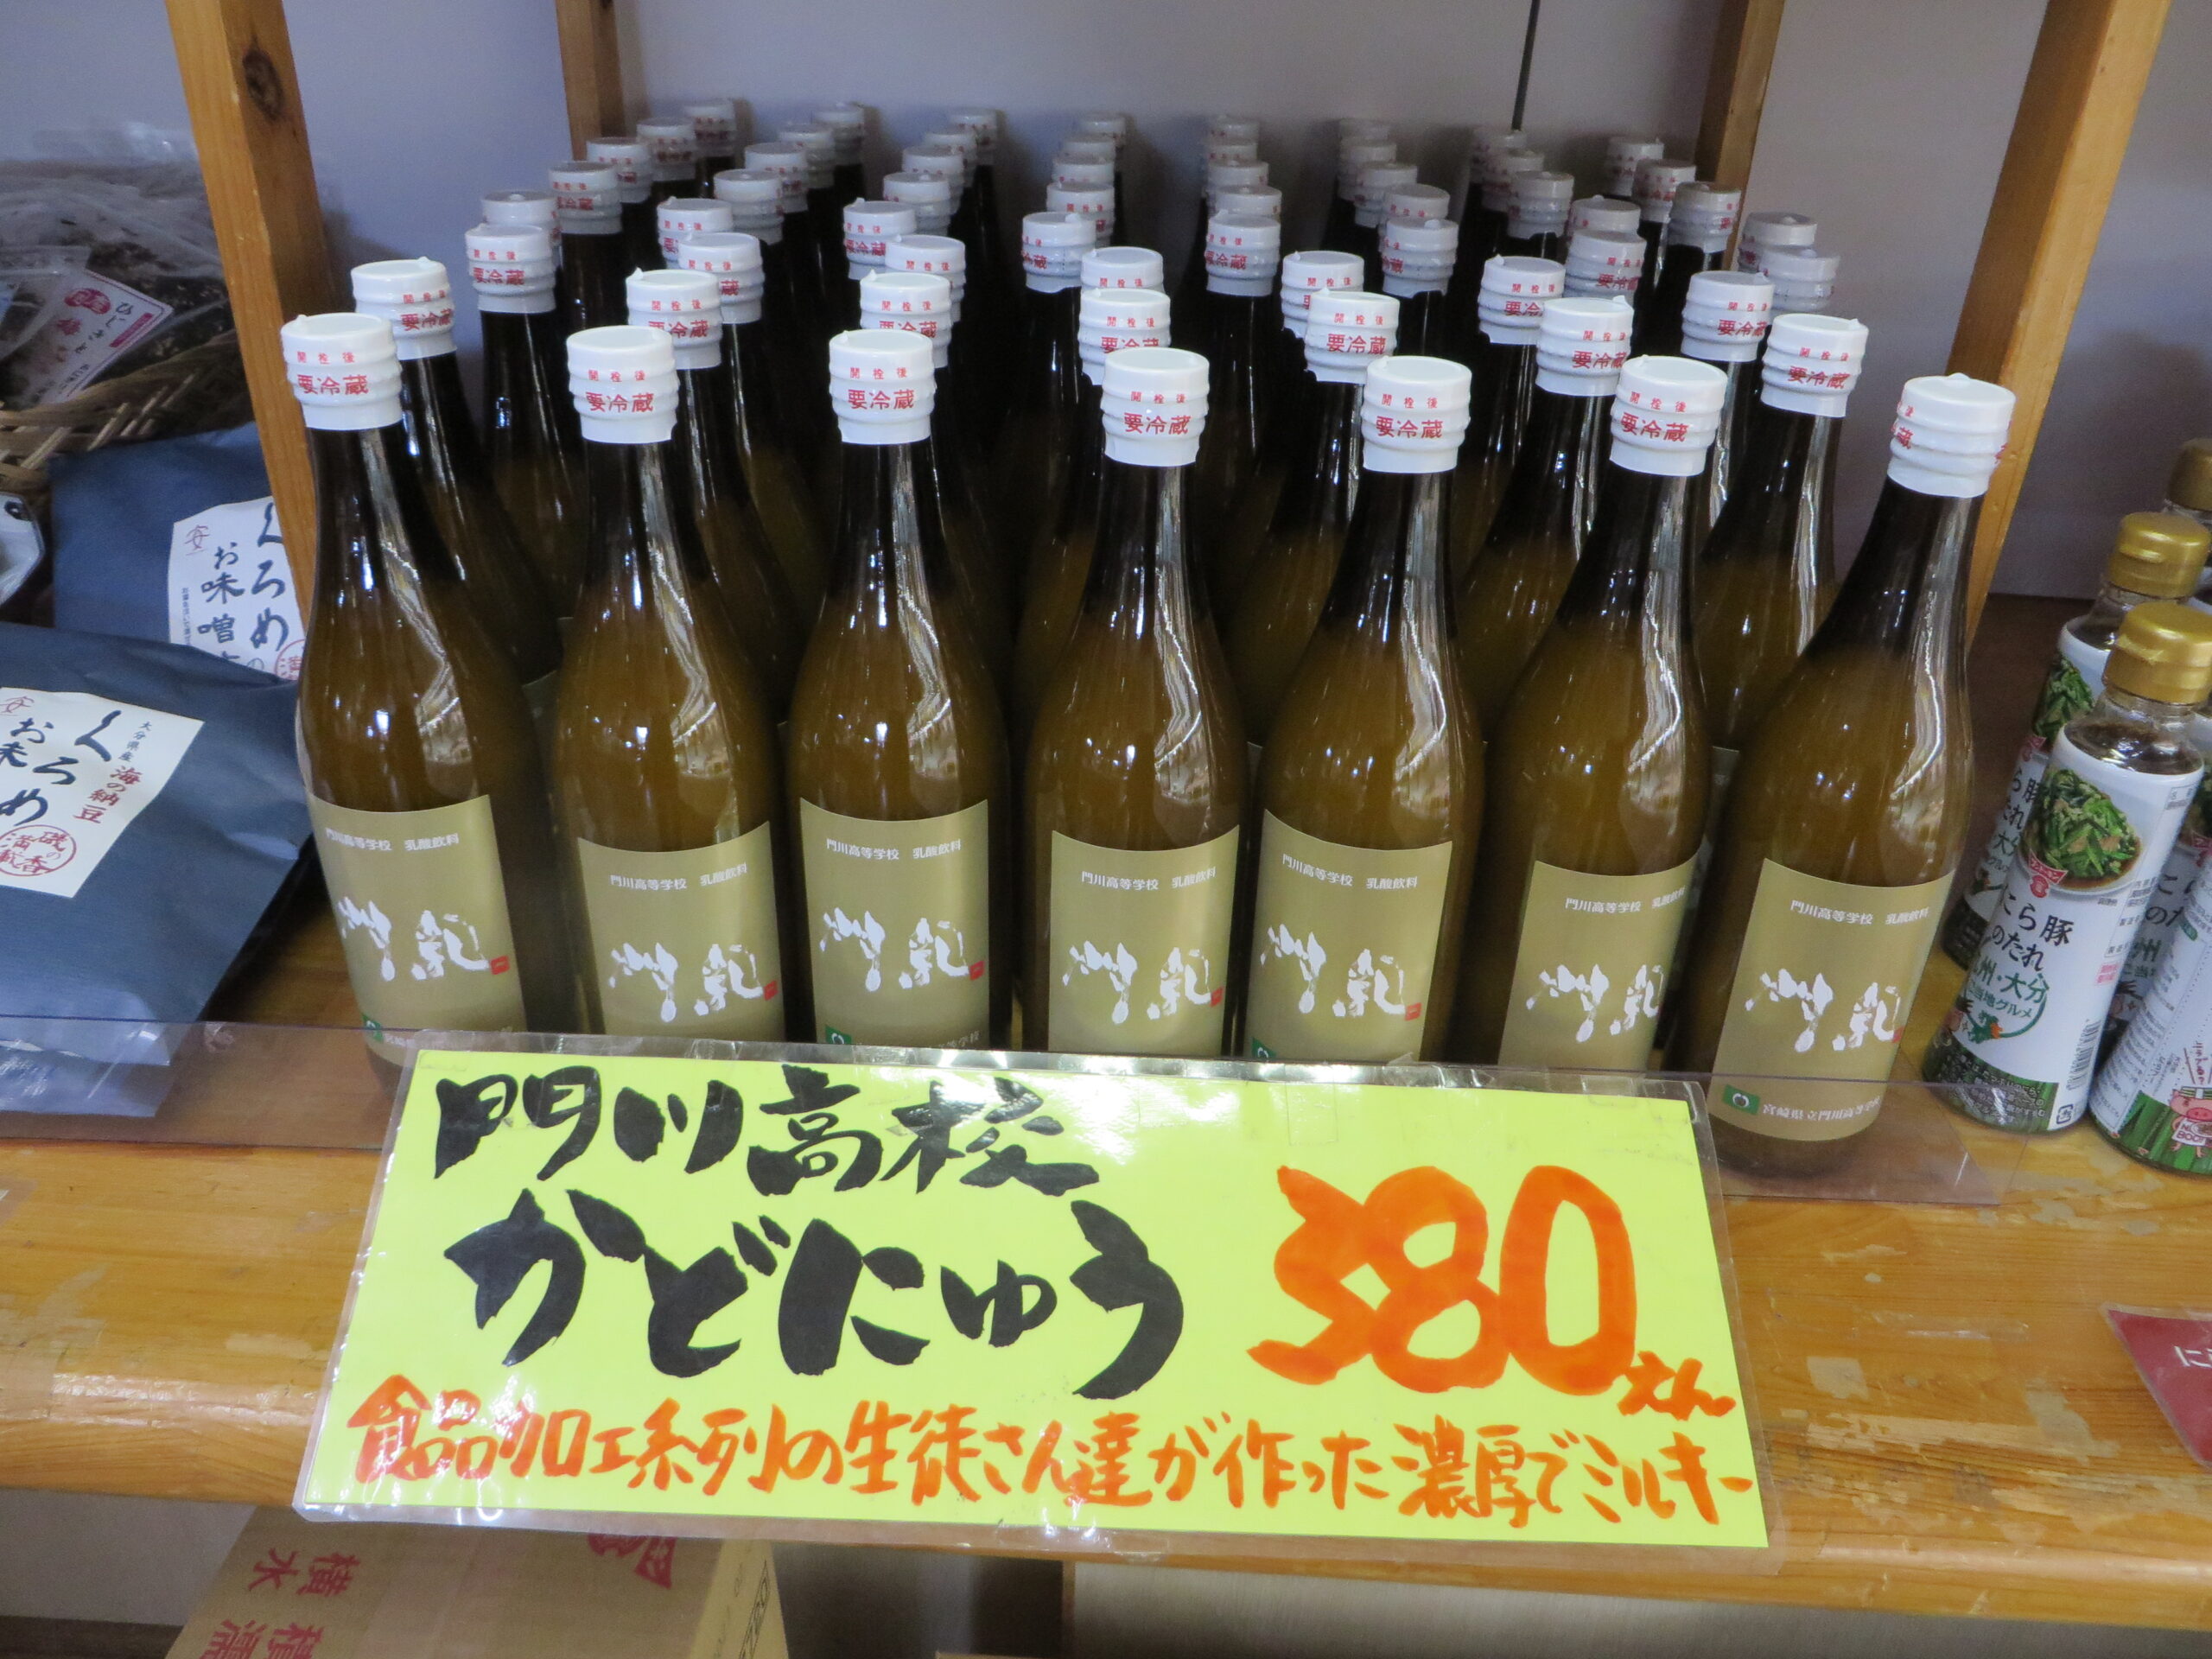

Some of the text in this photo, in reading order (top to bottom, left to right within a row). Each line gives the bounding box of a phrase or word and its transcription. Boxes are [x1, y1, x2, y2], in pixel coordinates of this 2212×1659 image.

[1327, 334, 1386, 354] 要冷蔵
[298, 375, 369, 394] 要冷蔵
[850, 367, 906, 380] 開栓後
[1789, 366, 1851, 388] 要冷蔵
[587, 392, 653, 412] 要冷蔵
[849, 390, 913, 409] 要冷蔵
[1382, 394, 1438, 408] 開栓後
[1630, 392, 1687, 412] 開栓後
[1124, 413, 1192, 435] 要冷蔵
[1376, 416, 1443, 437] 要冷蔵
[1621, 410, 1689, 441] 要冷蔵
[251, 502, 289, 652] くろめ
[198, 542, 245, 660] お味噌
[0, 710, 121, 826] くろめ
[73, 721, 152, 823] 大分県産 海の納豆
[827, 839, 961, 860] 門川高等学校 乳酸飲料
[1082, 871, 1158, 890] 門川高等学校
[1283, 854, 1417, 888] 門川高等学校 乳酸飲料
[611, 875, 686, 890] 門川高等学校
[1566, 899, 1641, 912] 門川高等学校
[1790, 900, 1873, 925] 門川高等学校
[1992, 925, 2044, 972] のたれ
[435, 1064, 1099, 1198] 門川高校
[444, 1188, 1184, 1400] かどにゅう
[346, 1374, 1755, 1529] 食品加工系列の生徒さん達が作った濃厚でミルキー
